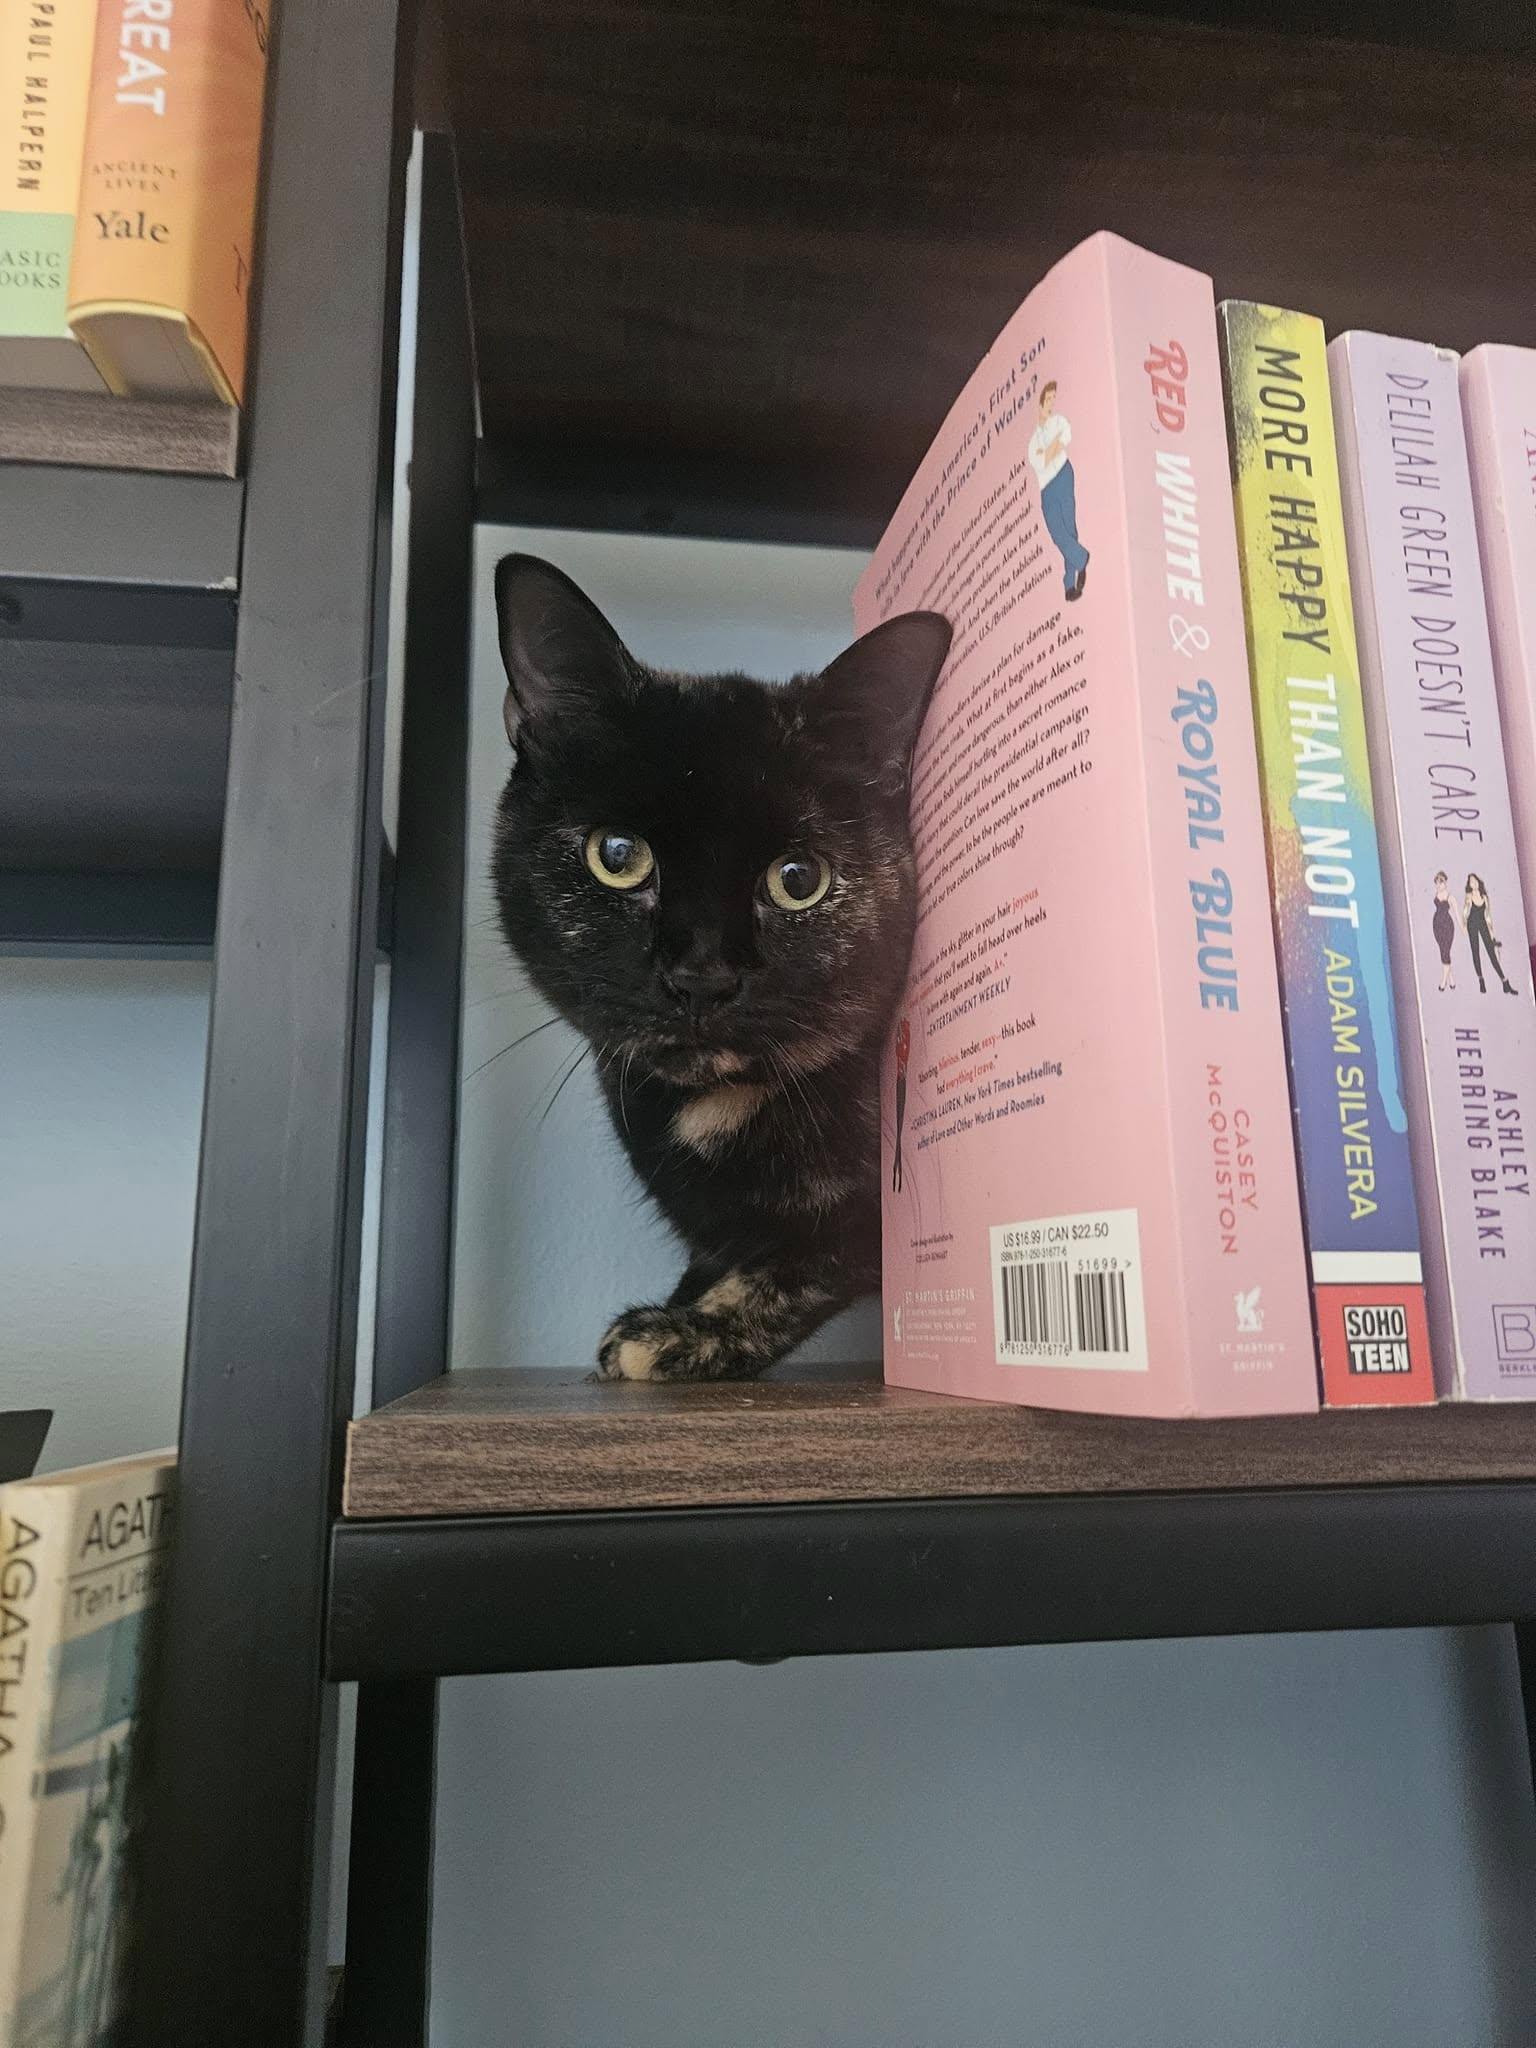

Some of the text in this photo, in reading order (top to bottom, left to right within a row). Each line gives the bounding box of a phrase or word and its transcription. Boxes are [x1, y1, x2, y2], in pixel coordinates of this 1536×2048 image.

[17, 3, 55, 191] PAUL HALPERN
[92, 161, 177, 180] ANCIENT
[105, 178, 160, 193] LIVES
[95, 211, 169, 244] Yale
[921, 336, 1045, 521] when America's First Son
[916, 525, 931, 560] with
[932, 505, 945, 531] the
[980, 429, 991, 459] of
[995, 373, 1038, 436] Wales?
[961, 505, 982, 542] United
[1008, 458, 1026, 486] Alex
[982, 475, 1028, 540] equivalent of
[999, 577, 1011, 595] the
[1012, 544, 1044, 581] tabloids
[1002, 544, 1018, 567] Alex
[1018, 528, 1033, 549] has
[1034, 522, 1039, 535] a
[1017, 565, 1052, 601] relations
[1386, 372, 1484, 843] DELILAH GREEN DOESN'T CARE
[970, 674, 991, 700] devise
[996, 653, 1013, 678] plan
[1013, 642, 1025, 658] for
[1026, 611, 1061, 646] damage
[1254, 344, 1360, 929] MORE HAPPY THAN NOT
[966, 704, 983, 728] What
[992, 680, 1007, 704] first
[1008, 659, 1034, 684] begins
[1036, 649, 1047, 665] as
[1049, 643, 1055, 655] a
[1057, 625, 1084, 648] fake,
[1006, 695, 1023, 716] than
[1024, 675, 1048, 701] either
[1050, 659, 1072, 681] Alex
[1073, 649, 1086, 665] or
[1143, 340, 1240, 1013] RED WHITE & ROYAL BLUE
[997, 732, 1012, 750] into
[1018, 704, 1043, 733] secret
[1044, 677, 1088, 714] romance
[964, 728, 1090, 830] Can love save the world after all?
[981, 774, 993, 790] the
[993, 731, 1039, 783] presidential
[1040, 705, 1090, 743] campaign
[981, 824, 993, 841] the
[992, 803, 1018, 836] people
[1018, 797, 1031, 813] we
[1031, 787, 1045, 804] are
[1046, 764, 1078, 794] meant
[1080, 760, 1093, 775] to
[974, 852, 992, 872] shine
[991, 823, 1025, 859] through?
[957, 928, 975, 951] glitter
[981, 912, 996, 935] your
[996, 904, 1011, 921] hair
[1011, 887, 1039, 915] joyous
[977, 939, 988, 959] fall
[988, 927, 1006, 952] head
[1006, 922, 1023, 940] over
[1023, 905, 1047, 929] heels
[963, 971, 975, 990] and
[978, 975, 1012, 1004] WEEKLY
[1016, 1012, 1036, 1035] book
[956, 1116, 974, 1133] Other
[974, 1106, 995, 1128] Words
[995, 1100, 1009, 1119] and
[1009, 1092, 1045, 1114] Roomies
[963, 1091, 977, 1106] New
[977, 1081, 992, 1101] York
[993, 1077, 1015, 1094] Times
[1015, 1060, 1063, 1086] bestselling
[1323, 947, 1378, 1221] ADAM SILVERA
[1233, 1108, 1259, 1211] CASEY
[1454, 1027, 1507, 1259] HERRING BLAKE
[1492, 1088, 1530, 1196] ASHLEY
[1003, 1231, 1015, 1248] US
[1015, 1229, 1041, 1247] $16.99
[1047, 1225, 1069, 1242] CAN
[1071, 1222, 1109, 1241] $22.50
[1347, 1308, 1404, 1338] SOHO
[1349, 1342, 1410, 1372] TEEN
[72, 1583, 113, 1618] Ten
